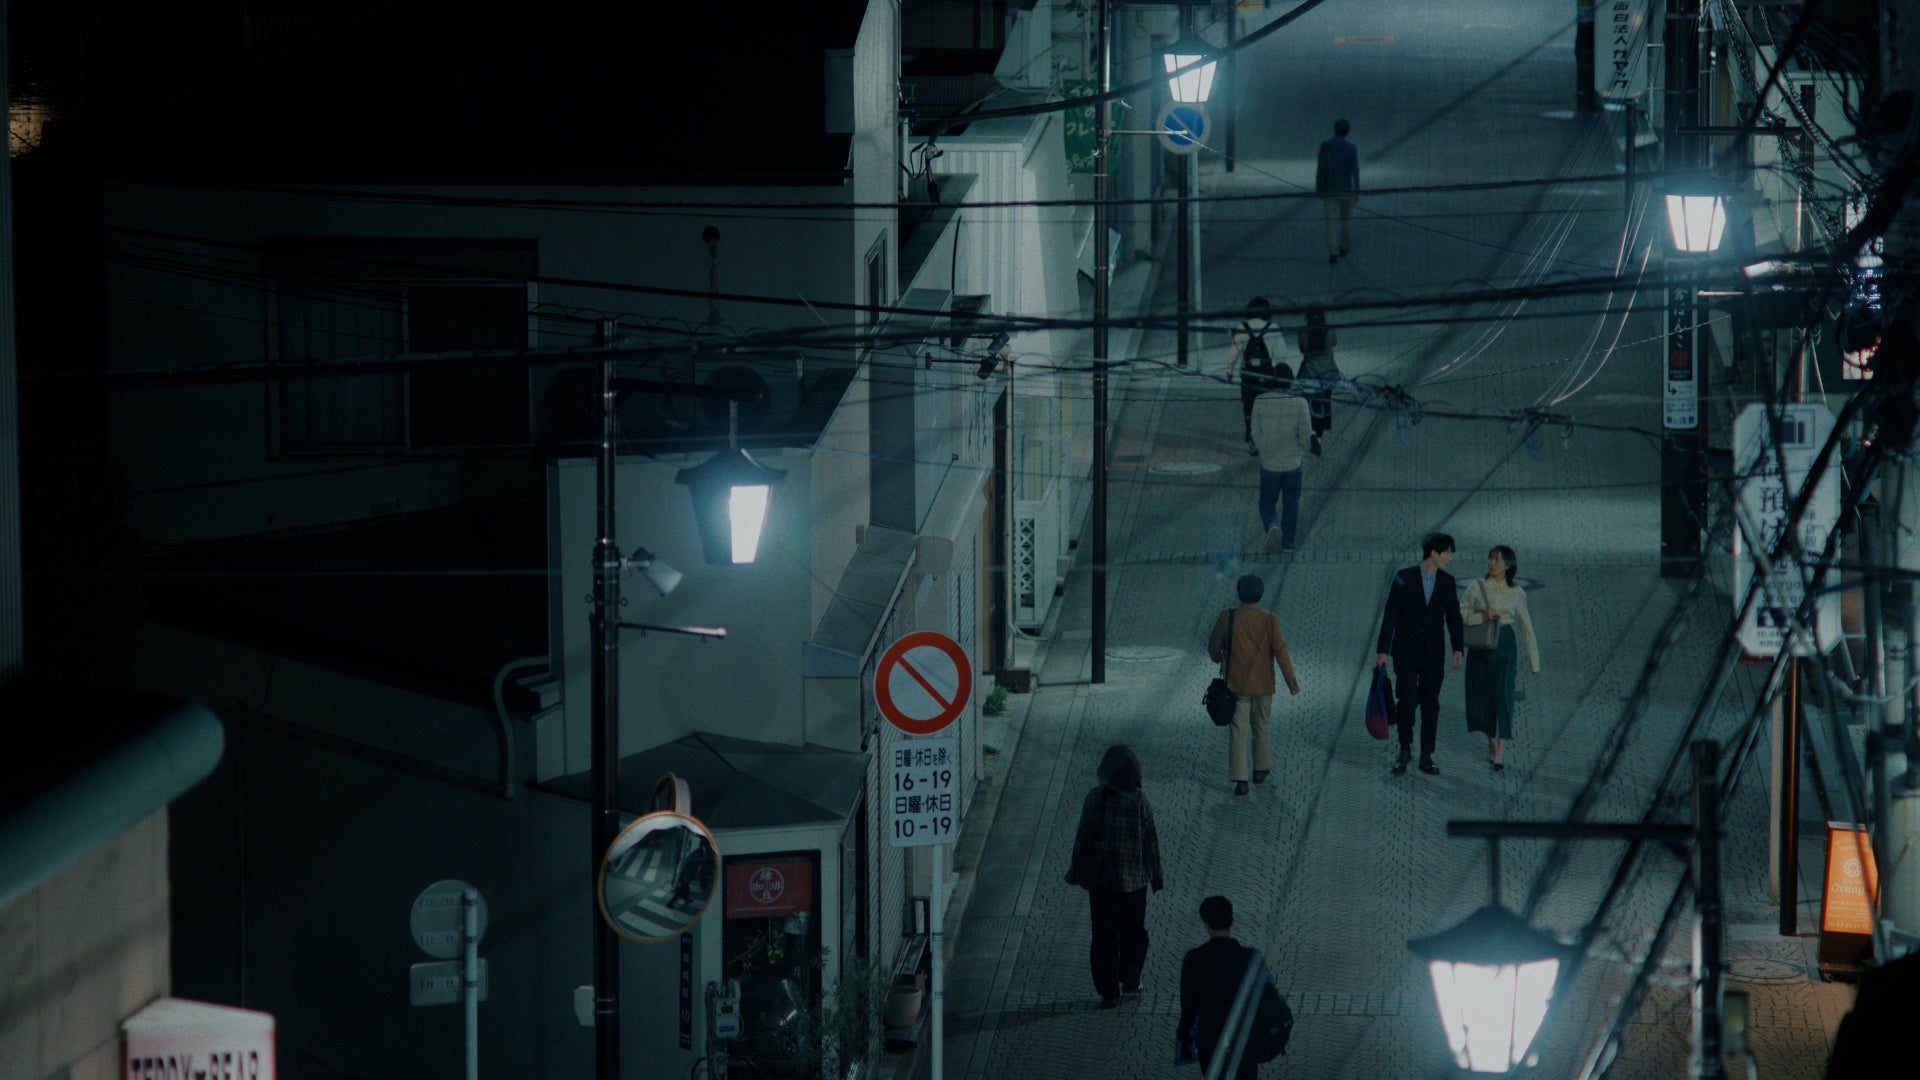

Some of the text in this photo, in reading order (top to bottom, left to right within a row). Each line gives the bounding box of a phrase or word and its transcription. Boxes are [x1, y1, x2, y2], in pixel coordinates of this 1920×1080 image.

[1613, 1, 1629, 89] 面白法人カヤック
[894, 770, 951, 792] 16-19
[894, 816, 951, 838] 10-19
[1831, 882, 1865, 897] Orang
